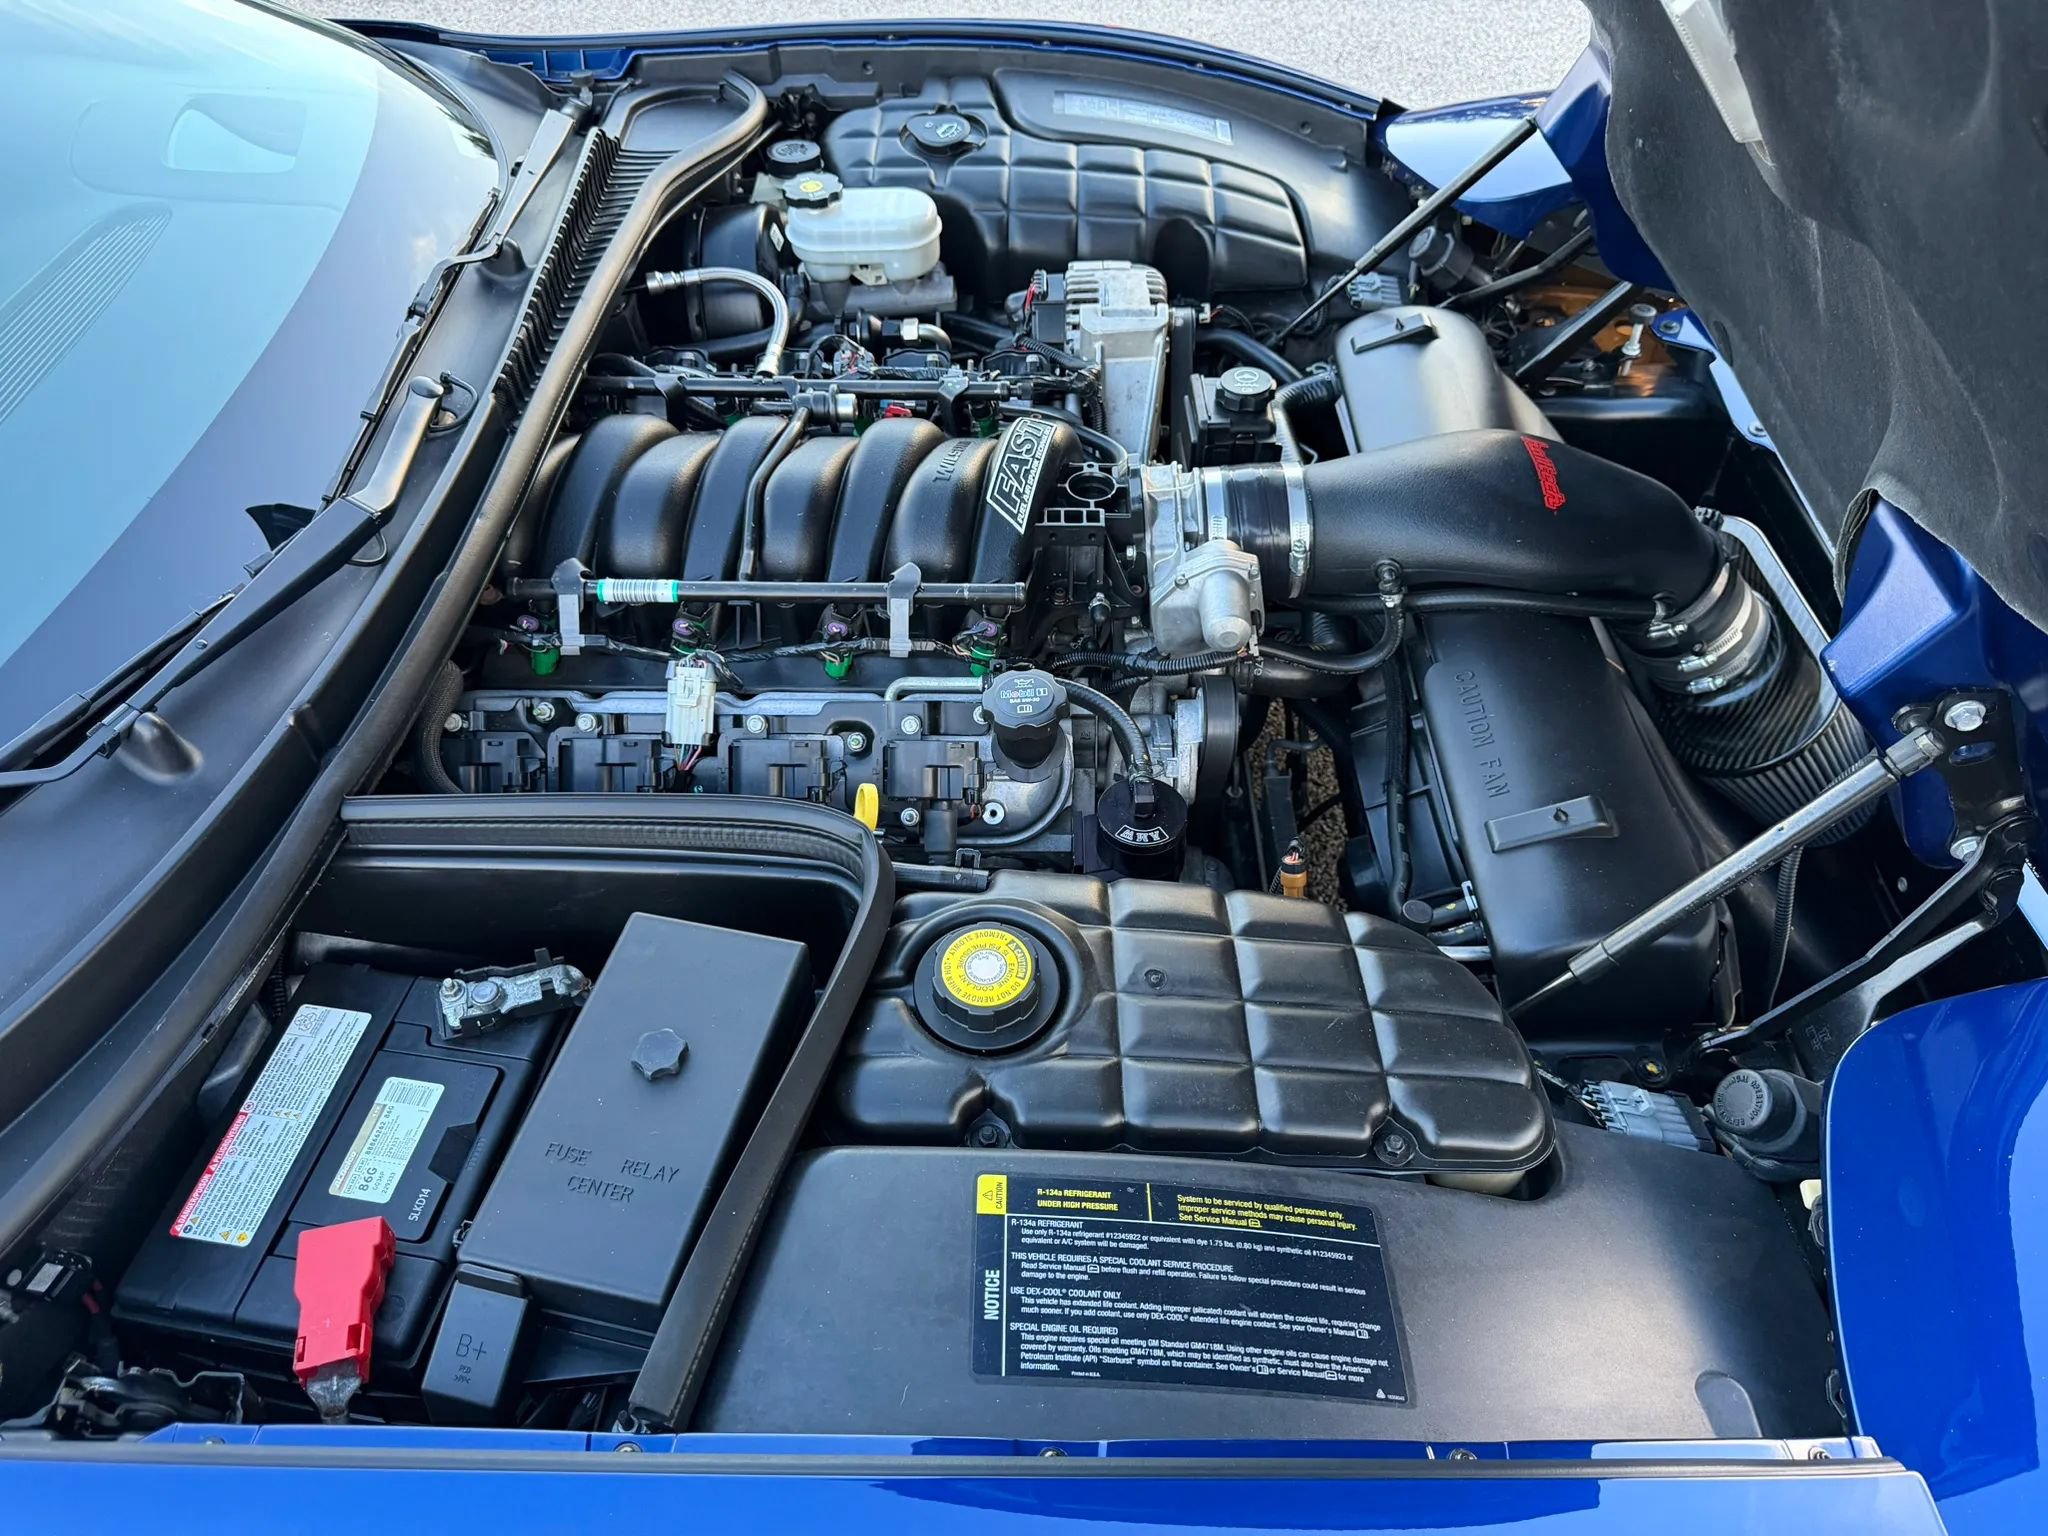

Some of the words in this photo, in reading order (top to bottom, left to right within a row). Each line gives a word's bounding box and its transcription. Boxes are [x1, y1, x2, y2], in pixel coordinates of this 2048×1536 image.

[993, 419, 1042, 514] FAST
[1027, 460, 1041, 485] SPARK
[1024, 483, 1034, 503] AIR
[1017, 502, 1028, 523] FUEL
[1000, 689, 1034, 698] Mobil
[1454, 671, 1495, 749] CAUTION
[1479, 757, 1510, 798] FAN
[949, 934, 974, 956] SLOWLY
[975, 930, 1006, 941] REMOVE
[946, 975, 962, 996] WHEN
[959, 974, 995, 992] COOLANT
[996, 963, 1015, 990] ENGINE
[1012, 981, 1022, 991] DO
[961, 991, 995, 1003] REMOVE
[996, 989, 1013, 1001] NOT
[1748, 1080, 1763, 1121] OPERATION
[545, 1142, 592, 1166] FUSE
[620, 1159, 680, 1183] RELAY
[357, 1166, 378, 1191] 86G
[567, 1175, 634, 1203] CENTER
[177, 1173, 212, 1223] DANGER/POISON
[1037, 1199, 1061, 1207] UNDER
[1081, 1202, 1117, 1210] PRESSURE
[1063, 1189, 1110, 1198] REFRIGERANT
[407, 1187, 432, 1223] SLKD14
[1177, 1194, 1202, 1203] System
[1213, 1197, 1222, 1205] be
[1223, 1198, 1252, 1208] serviced
[1253, 1201, 1262, 1209] by
[1263, 1203, 1292, 1212] qualified
[1294, 1207, 1327, 1216] personnel
[1178, 1204, 1208, 1213] Improper
[1211, 1207, 1235, 1215] service
[1237, 1209, 1267, 1218] methods
[1306, 1217, 1335, 1226] personal
[1011, 1218, 1035, 1226] R-134a
[1037, 1219, 1082, 1228] REFRIGERANT
[1193, 1214, 1219, 1223] Service
[1221, 1216, 1247, 1225] Manual
[1021, 1236, 1052, 1244] equivalent
[1072, 1230, 1104, 1238] refrigerant
[1149, 1235, 1180, 1243] equivalent
[1196, 1238, 1207, 1246] dye
[1276, 1246, 1302, 1254] synthetic
[1028, 1252, 1055, 1260] VEHICLE
[1057, 1254, 1091, 1262] REQUIRES
[1099, 1256, 1125, 1264] SPECIAL
[1129, 1258, 1160, 1266] COOLANT
[1162, 1260, 1190, 1268] SERVICE
[1192, 1262, 1232, 1272] PROCEDURE
[1063, 1263, 1085, 1271] Manual
[1101, 1265, 1120, 1273] before
[1228, 1274, 1246, 1282] follow
[1248, 1276, 1269, 1284] special
[1270, 1279, 1300, 1287] procedure
[984, 1268, 999, 1320] NOTICE
[1068, 1289, 1100, 1297] COOLANT
[1103, 1290, 1120, 1298] ONLY
[1139, 1302, 1161, 1311] Adding
[1163, 1305, 1190, 1313] improper
[1192, 1306, 1222, 1314] (silicated)
[1295, 1315, 1317, 1323] coolant
[1331, 1319, 1358, 1328] requiring
[1358, 1322, 1380, 1331] change
[1010, 1322, 1037, 1331] SPECIAL
[1041, 1323, 1066, 1332] ENGINE
[1069, 1325, 1080, 1333] OIL
[1082, 1325, 1117, 1334] REQUIRED
[456, 1333, 487, 1360] B+
